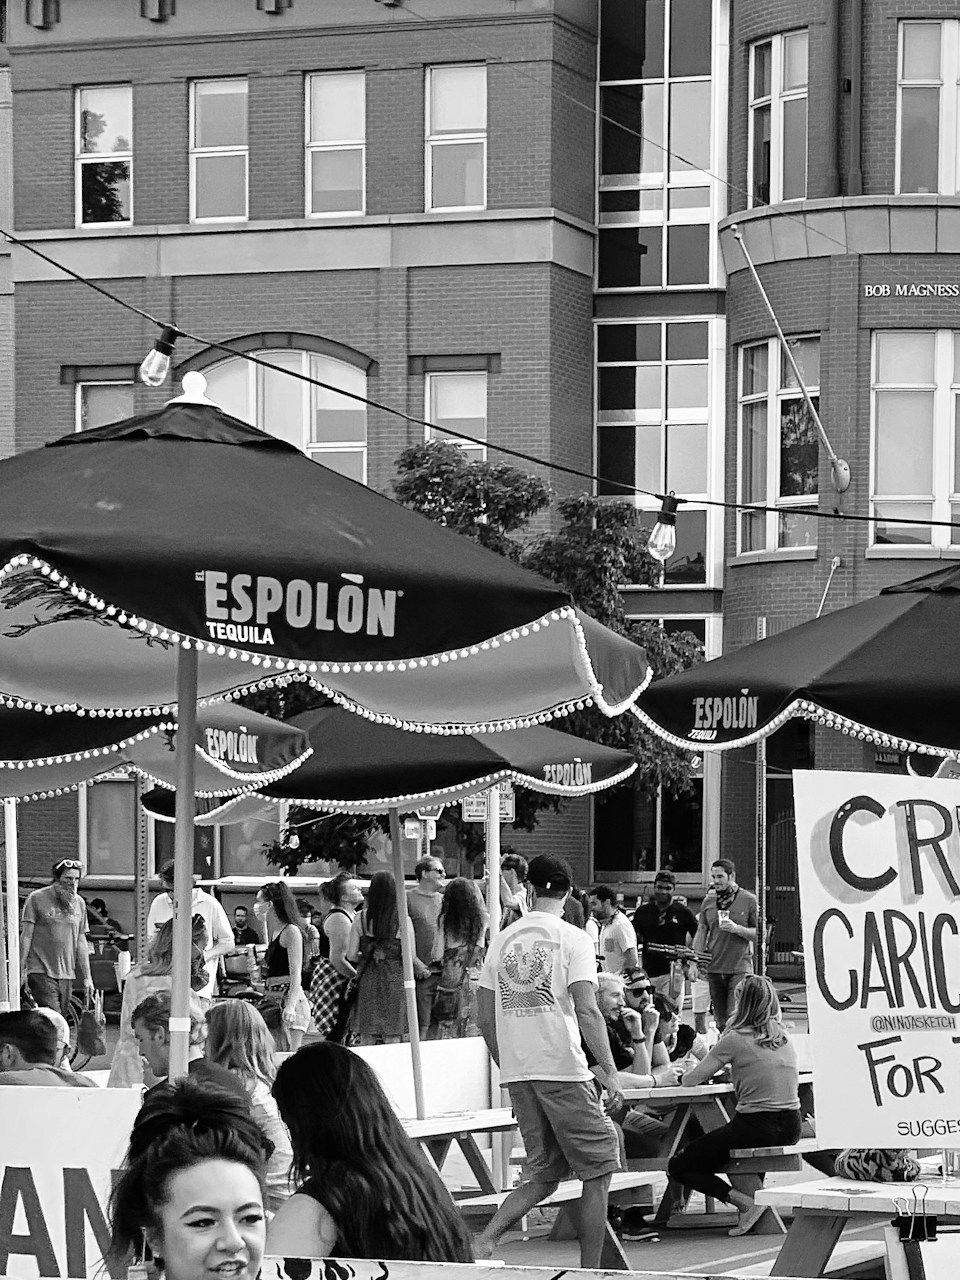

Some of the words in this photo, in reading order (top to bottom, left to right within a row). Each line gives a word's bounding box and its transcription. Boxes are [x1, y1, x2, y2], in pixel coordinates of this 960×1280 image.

[865, 285, 890, 297] BOB
[895, 284, 959, 297] MAGNESS
[206, 621, 274, 645] TEQUILA
[872, 1015, 957, 1032] @NINJASKETCH
